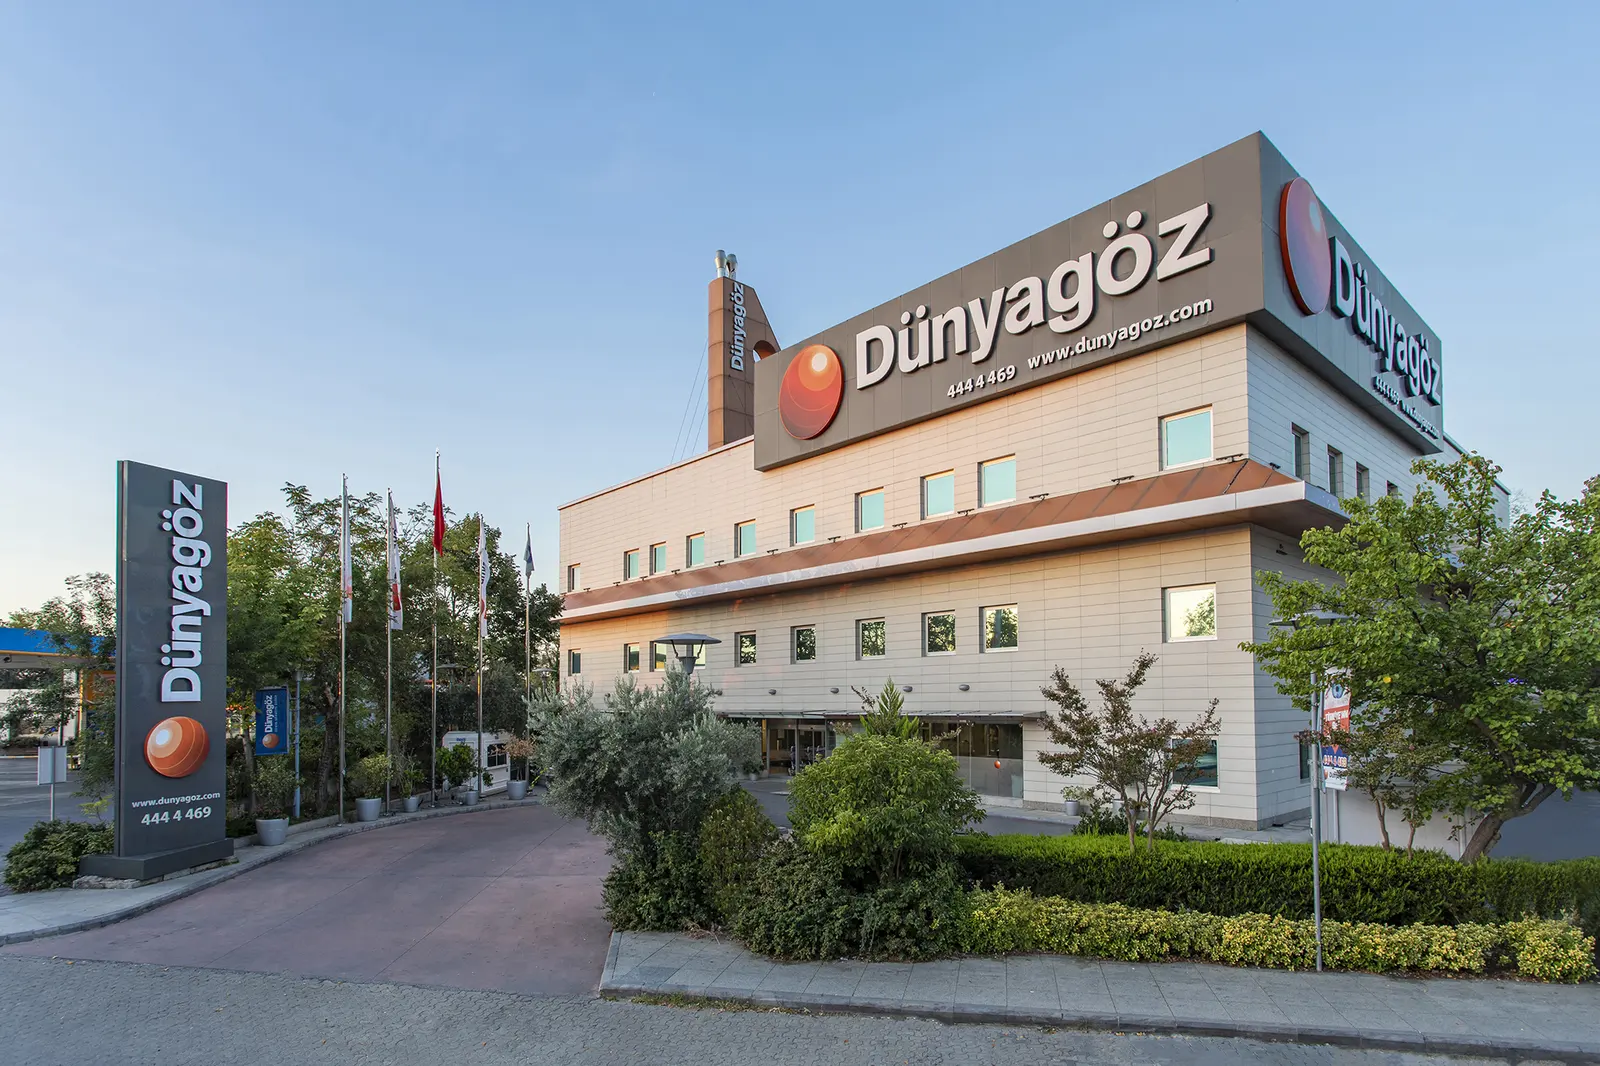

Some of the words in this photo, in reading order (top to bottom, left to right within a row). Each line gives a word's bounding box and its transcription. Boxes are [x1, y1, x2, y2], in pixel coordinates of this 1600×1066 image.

[730, 281, 747, 371] Dünyagöz
[856, 202, 1213, 390] Dünyagöz
[1027, 298, 1213, 369] www.dunyagoz.com
[1329, 236, 1440, 406] Dünyagöz
[160, 479, 212, 702] Dünyagöz
[264, 695, 275, 733] Dünyagöz
[132, 792, 221, 808] www.dunyagoz.com
[141, 811, 170, 826] 444
[172, 810, 183, 822] 4
[185, 806, 212, 820] 469
